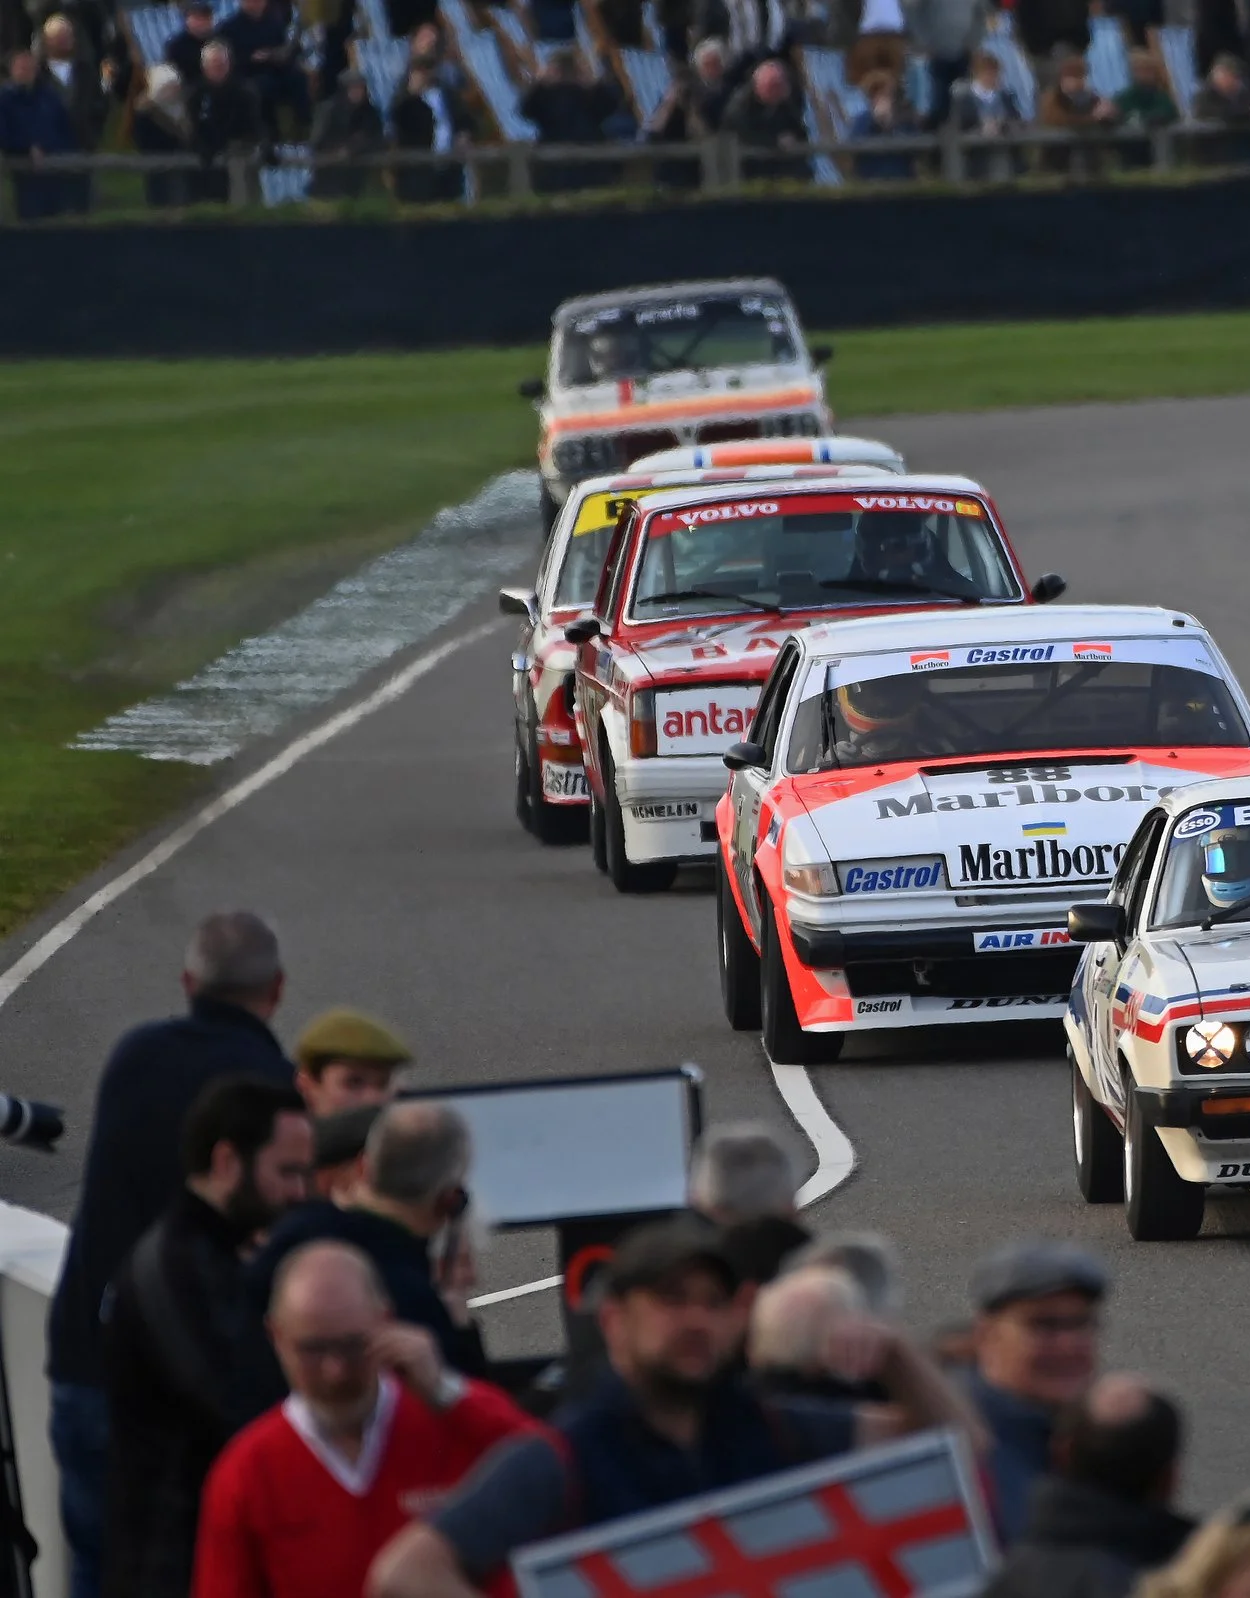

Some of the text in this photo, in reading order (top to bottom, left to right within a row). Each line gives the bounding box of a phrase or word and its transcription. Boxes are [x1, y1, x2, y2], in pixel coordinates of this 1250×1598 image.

[677, 502, 779, 525] VOLVO
[853, 497, 954, 511] VOLVO
[966, 645, 1055, 664] Castrol
[1073, 652, 1112, 662] Marlboro
[911, 661, 949, 671] Marlboro
[986, 767, 1072, 784] 88
[845, 862, 941, 893] Castrol
[979, 933, 1034, 948] AIR
[857, 999, 901, 1014] Castrol
